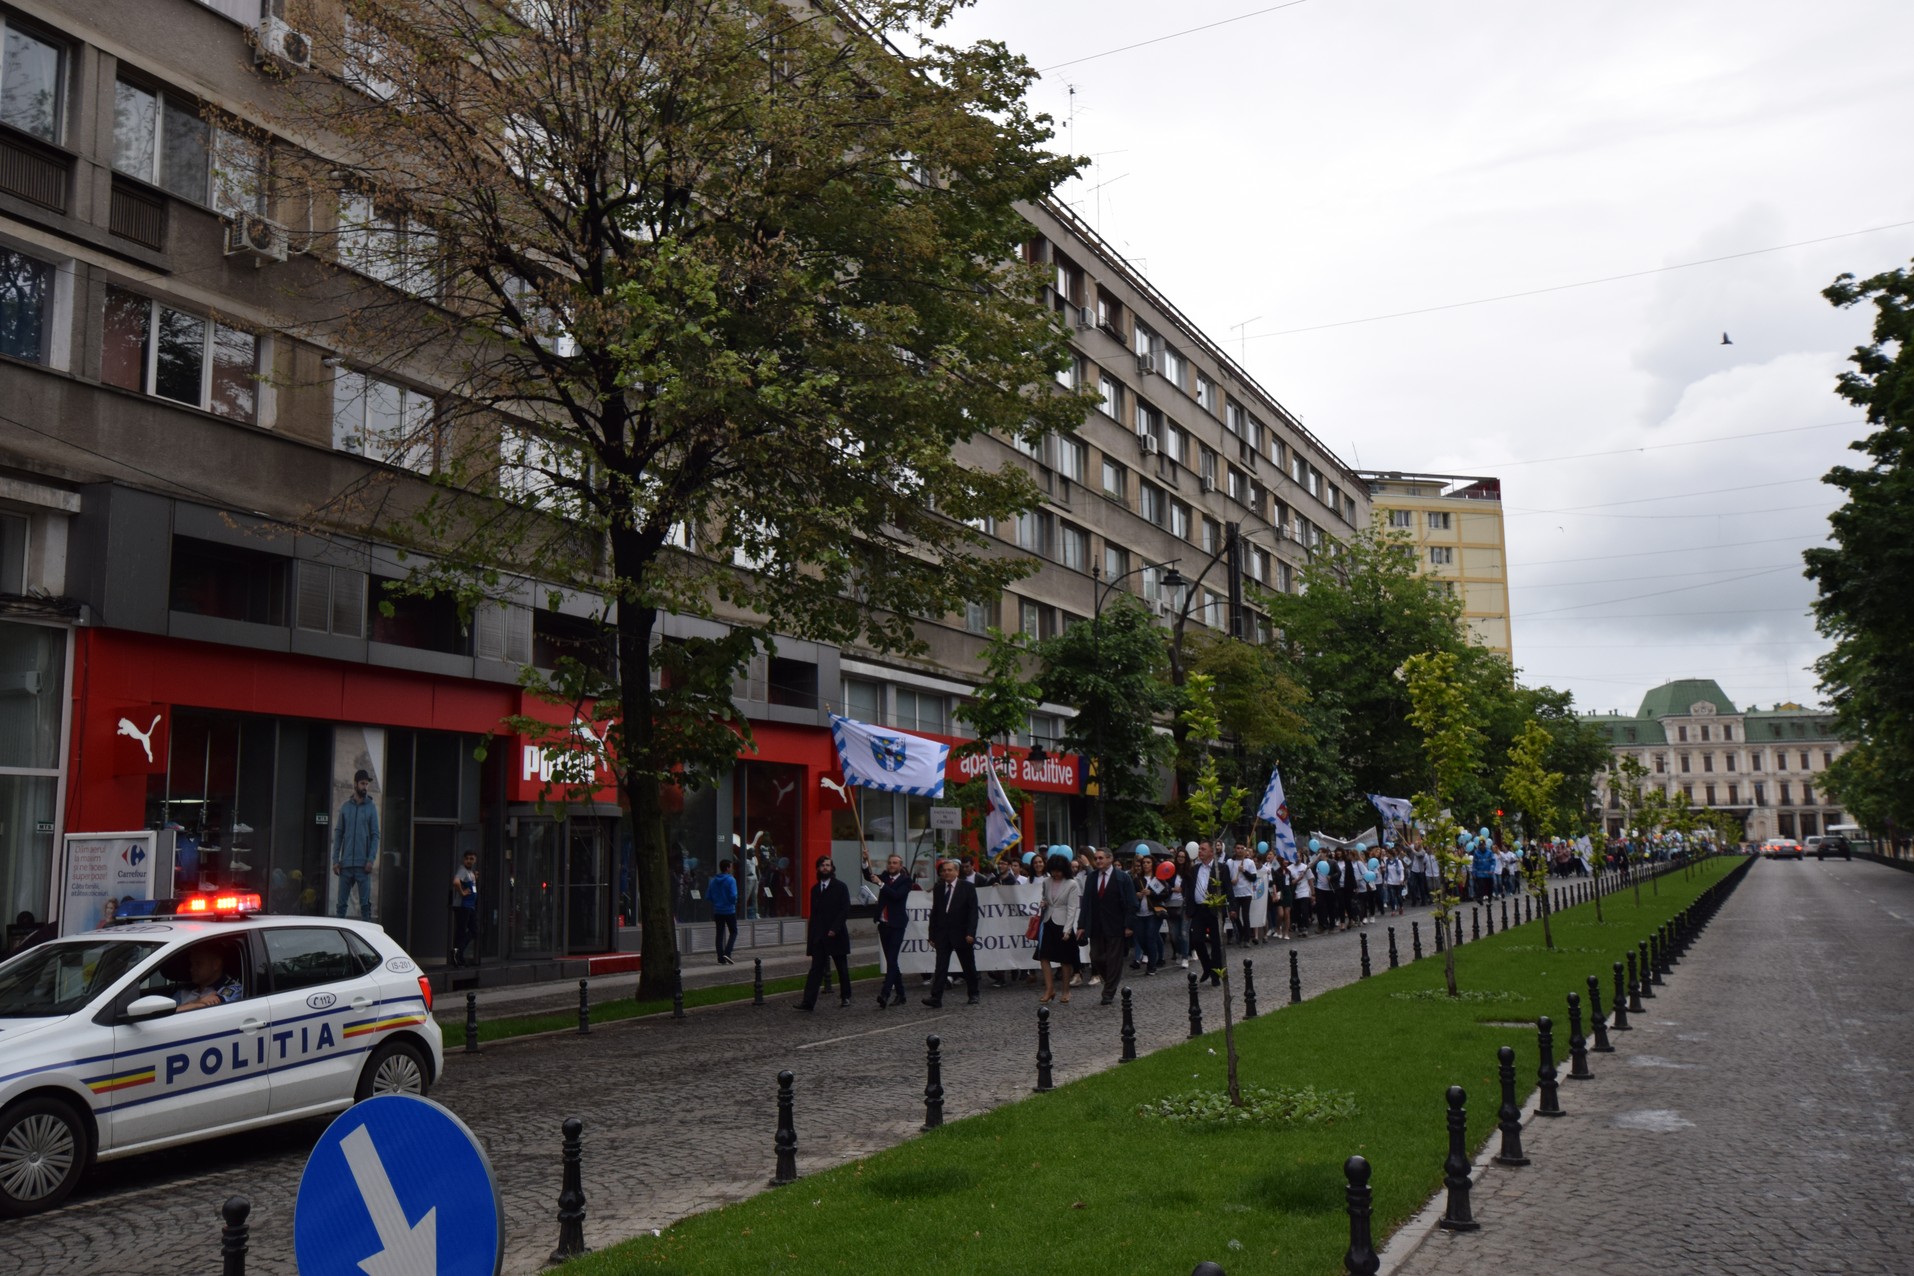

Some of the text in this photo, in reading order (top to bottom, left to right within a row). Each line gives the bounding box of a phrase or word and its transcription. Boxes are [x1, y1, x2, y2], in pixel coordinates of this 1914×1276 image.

[960, 751, 1017, 779] apaate
[117, 869, 147, 878] Carrefour
[973, 934, 1037, 951] SOLVE
[391, 960, 411, 970] IS-201
[320, 995, 331, 1005] 112
[166, 1022, 335, 1085] POLITIA
